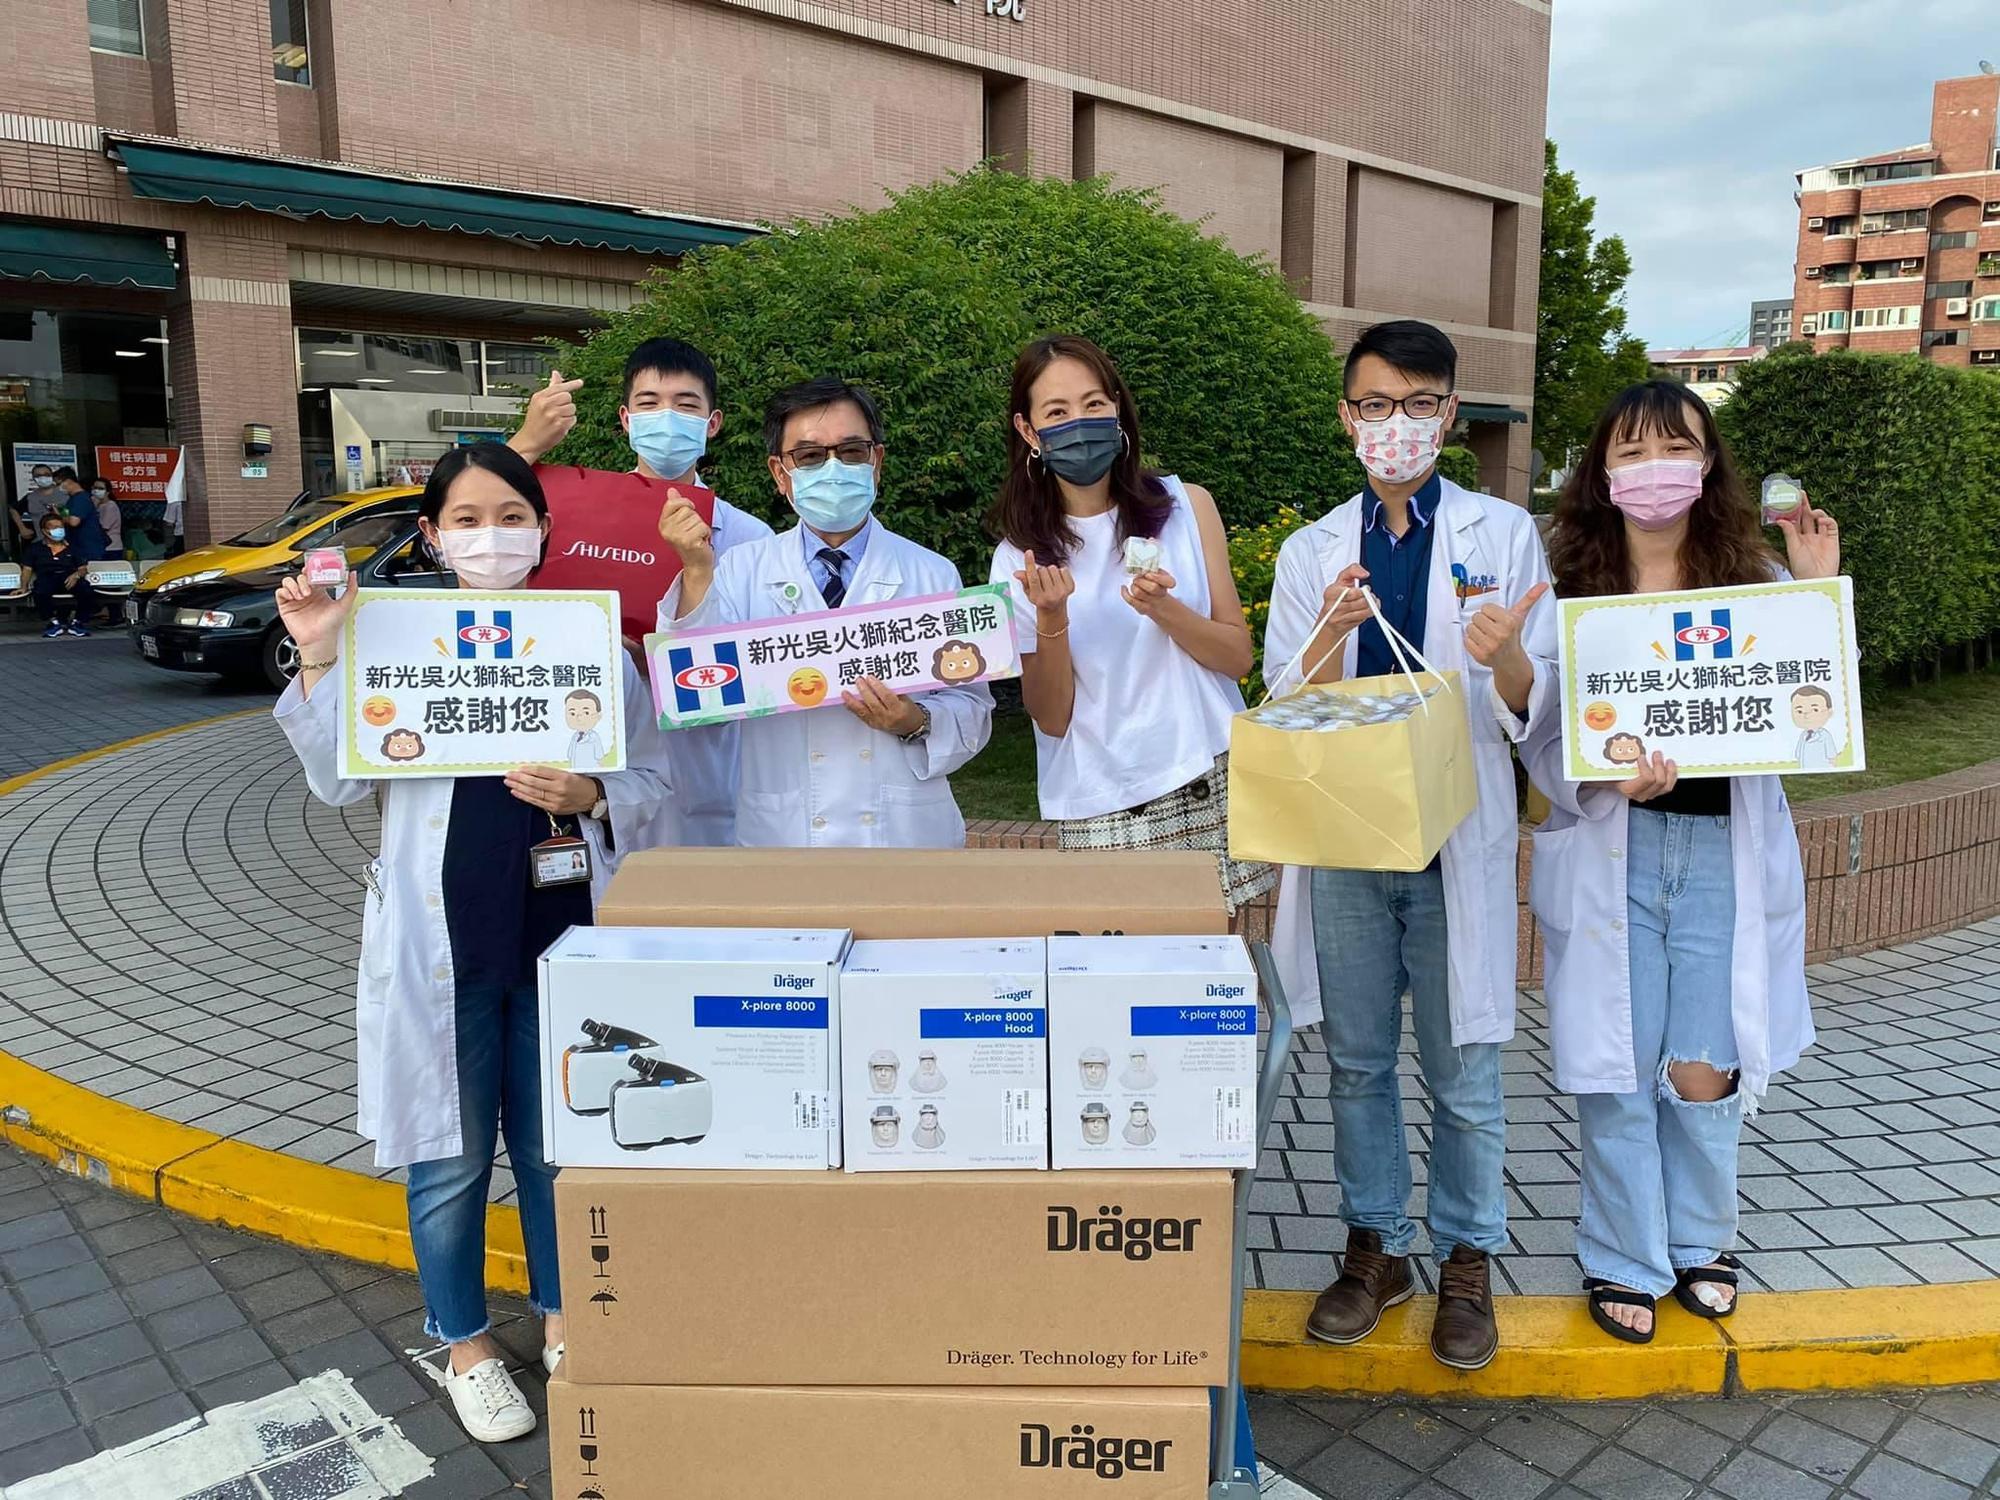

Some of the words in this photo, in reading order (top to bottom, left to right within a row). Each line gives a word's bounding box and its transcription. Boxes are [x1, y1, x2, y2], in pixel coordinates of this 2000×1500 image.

[562, 540, 655, 565] SHISEIDO
[748, 604, 998, 665] 新光吳火獅紀念醫院
[365, 664, 602, 690] 新光吳火獅紀念醫院
[838, 651, 921, 687] 感謝您
[1586, 658, 1832, 696] 新光吳火獅紀念醫院
[422, 696, 551, 735] 感謝您
[1643, 695, 1775, 738] 感謝您
[773, 974, 816, 990] Dräger
[1206, 984, 1245, 998] Dräger
[741, 1000, 782, 1012] X-plore
[785, 1000, 816, 1011] 8000
[963, 1012, 1002, 1023] X-plore
[1005, 1012, 1034, 1022] 8000
[1179, 1009, 1218, 1021] X-plore
[1219, 1009, 1246, 1020] 8000
[1005, 1023, 1034, 1034] Hood
[1217, 1021, 1246, 1031] Hood
[1048, 1206, 1202, 1261] Dräger
[946, 1349, 1015, 1369] Dräger.
[1019, 1349, 1128, 1369] Technology
[1131, 1350, 1159, 1366] for
[1020, 1423, 1173, 1479] Dräger
